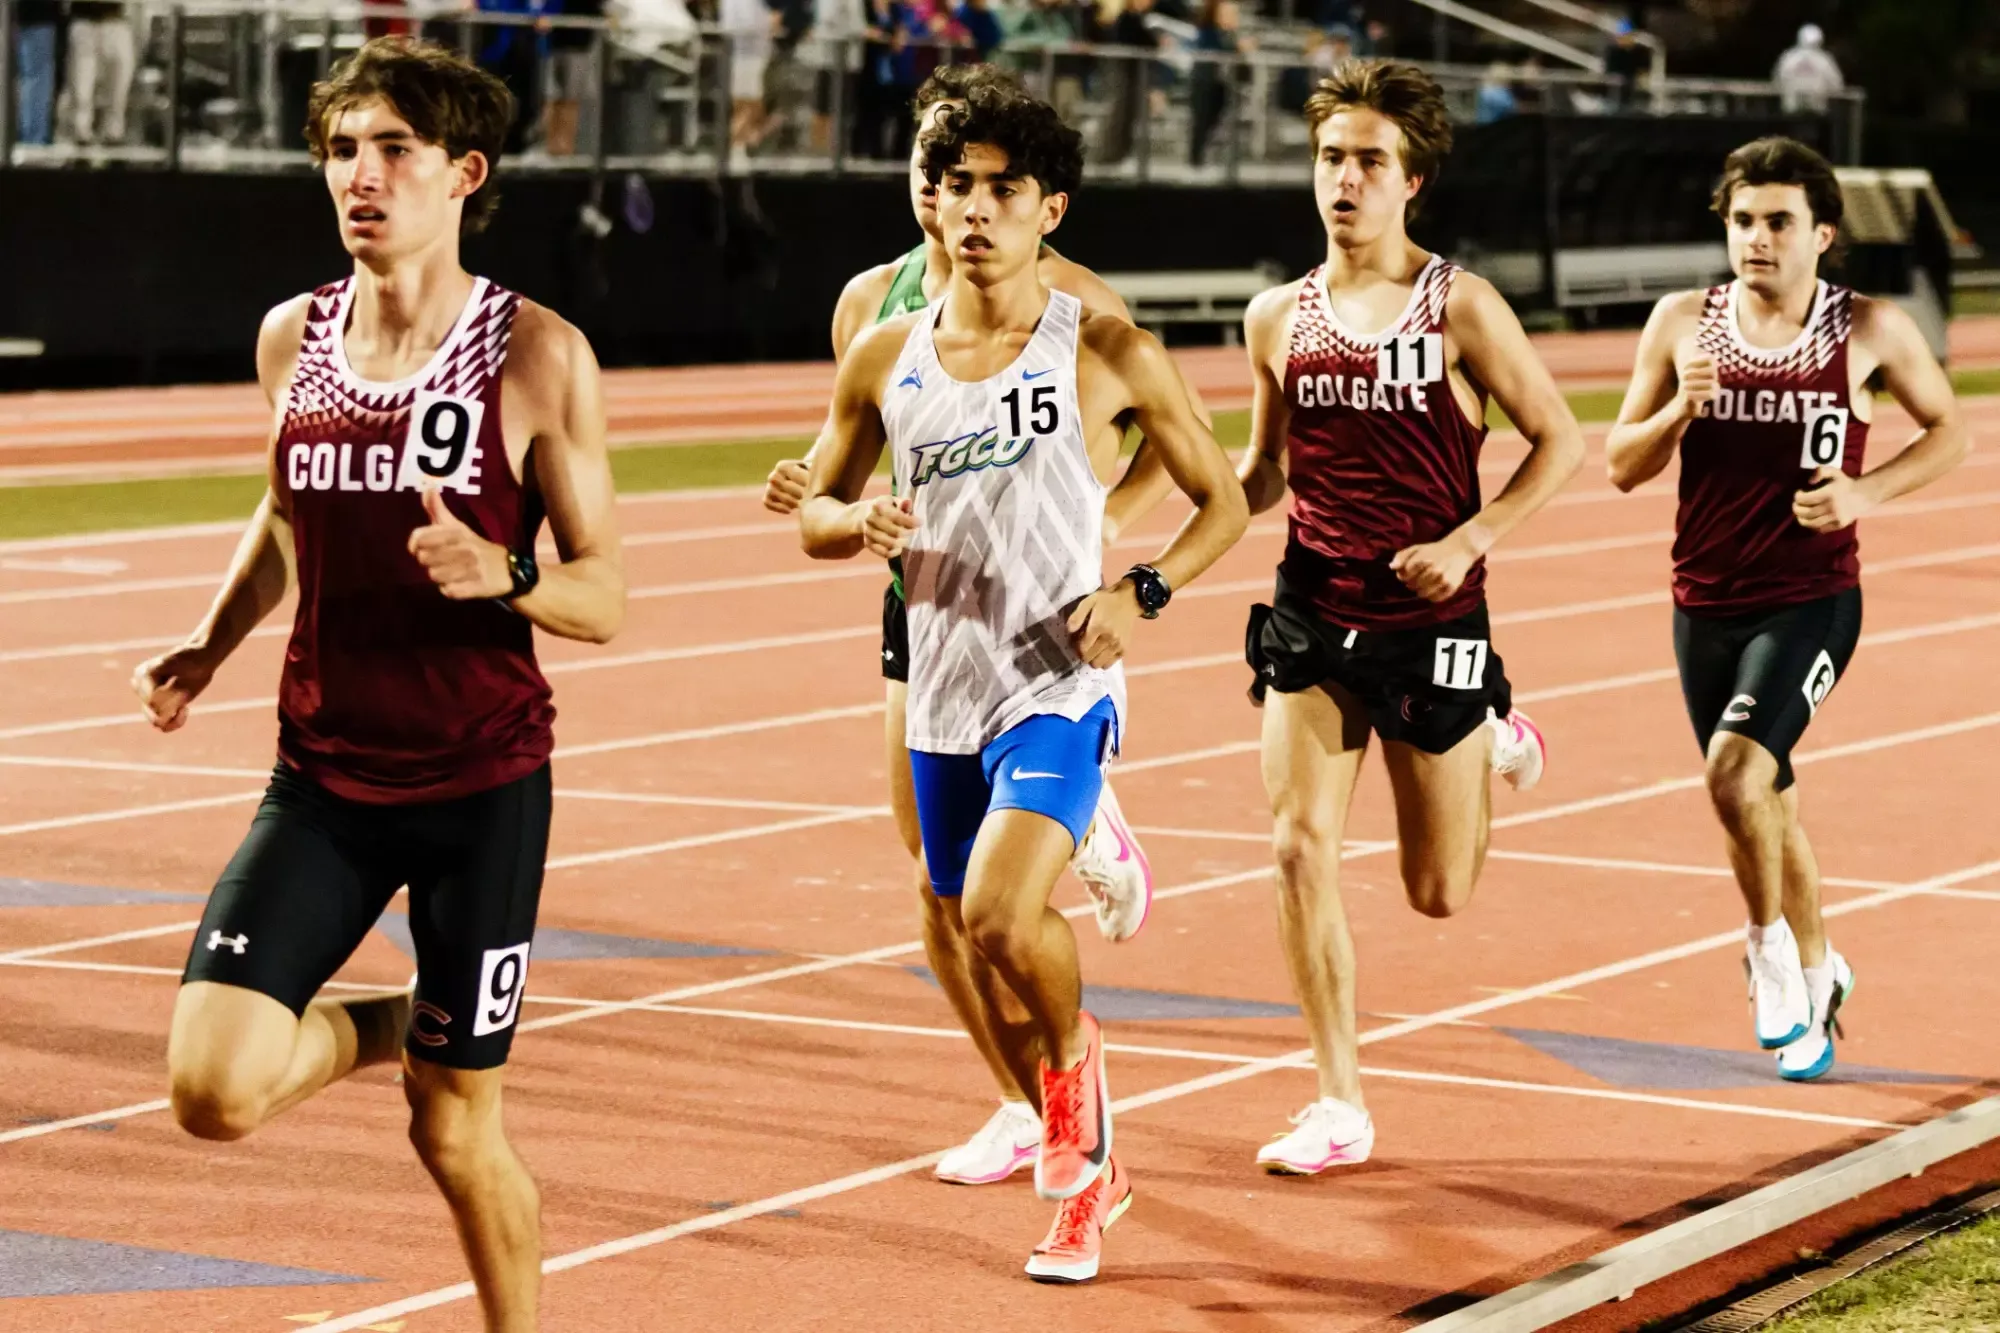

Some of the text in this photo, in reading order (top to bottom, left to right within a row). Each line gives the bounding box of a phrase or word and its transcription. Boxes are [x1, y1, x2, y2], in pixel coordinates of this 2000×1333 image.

[1383, 336, 1426, 381] 11
[1000, 386, 1059, 437] 15
[416, 400, 470, 478] 9
[1810, 413, 1841, 465] 6
[1441, 642, 1478, 686] 11
[1811, 663, 1832, 707] 6
[487, 952, 521, 1025] 9
